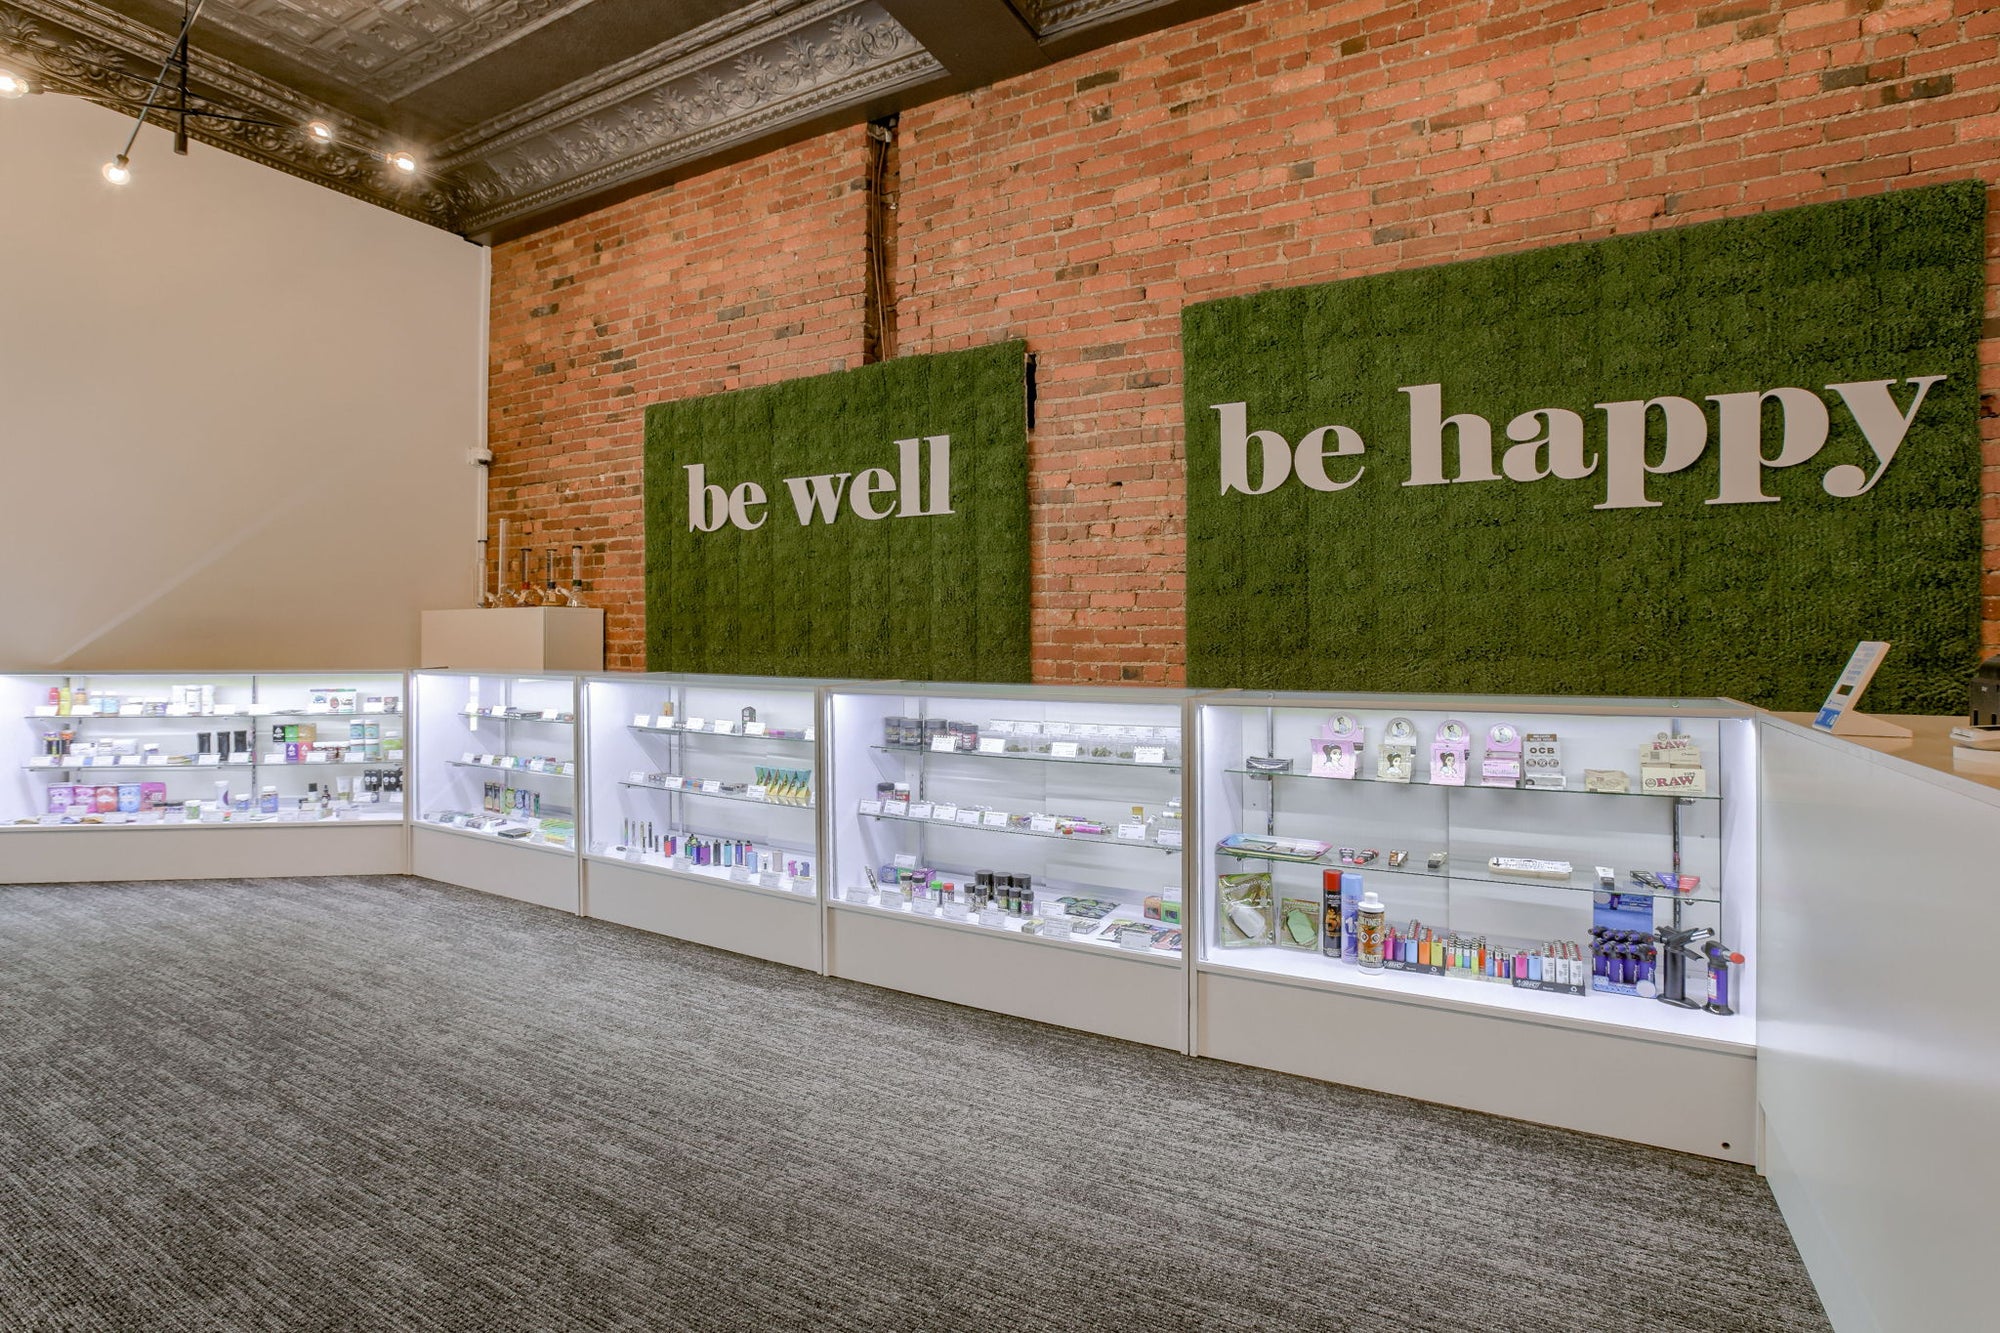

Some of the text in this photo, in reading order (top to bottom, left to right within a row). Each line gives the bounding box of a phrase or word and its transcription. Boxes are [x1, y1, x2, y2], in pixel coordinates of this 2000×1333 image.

[1209, 374, 1948, 510] be happy
[683, 434, 956, 533] be well
[1529, 746, 1556, 755] OCB
[1651, 739, 1689, 751] RAW
[1655, 774, 1696, 788] RAW
